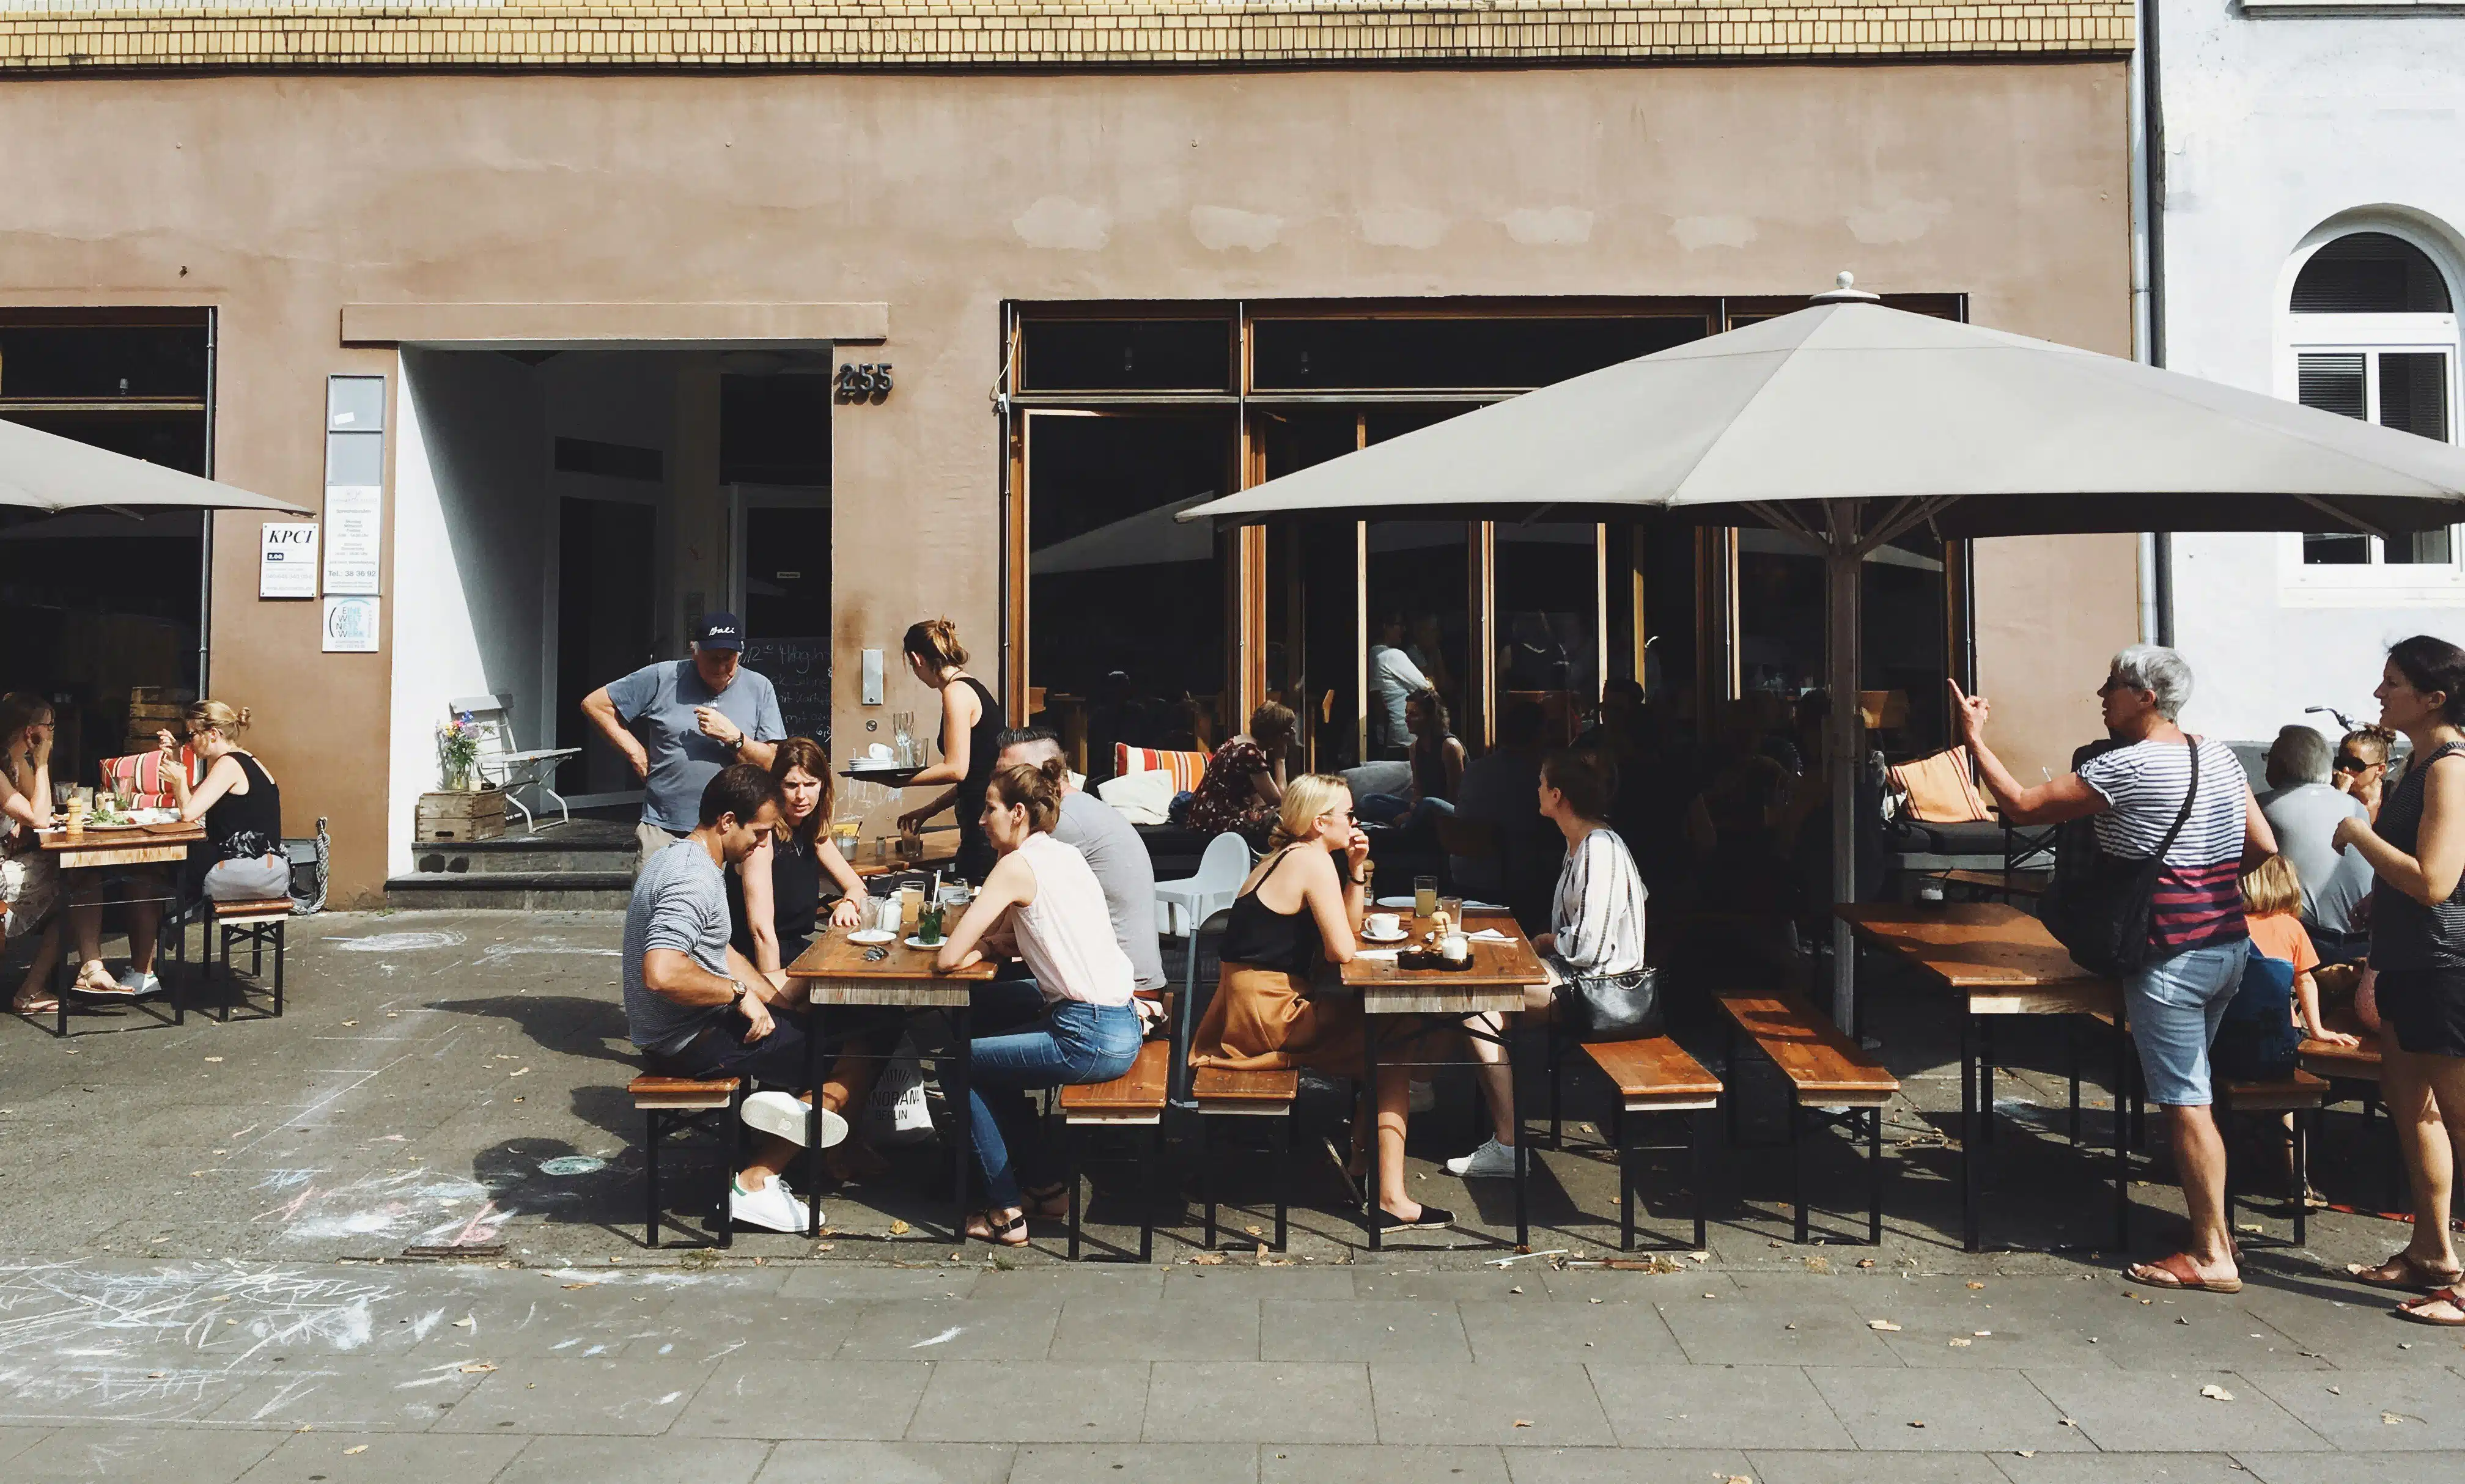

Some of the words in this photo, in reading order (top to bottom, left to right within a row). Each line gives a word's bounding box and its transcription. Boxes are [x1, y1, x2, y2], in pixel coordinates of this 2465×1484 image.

[839, 363, 893, 392] 255
[268, 530, 313, 543] KPCI
[709, 626, 735, 636] Bali
[877, 1109, 908, 1121] BERLIN
